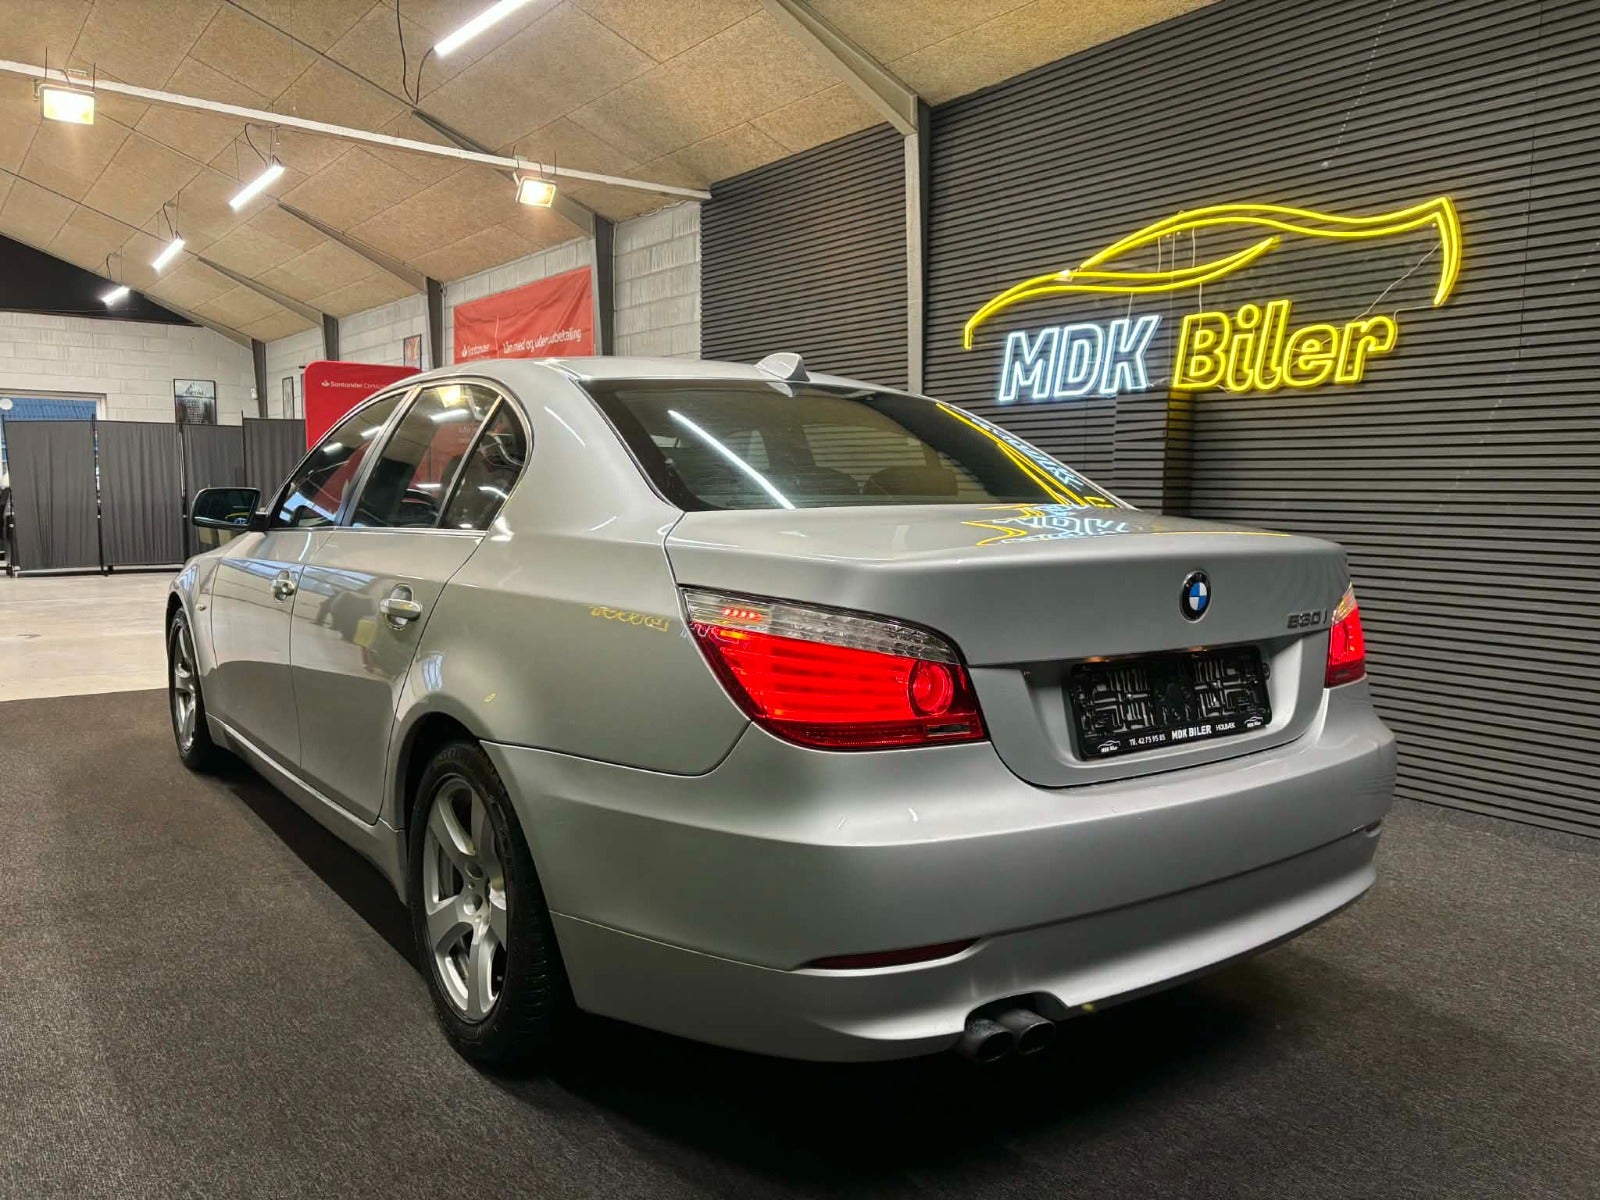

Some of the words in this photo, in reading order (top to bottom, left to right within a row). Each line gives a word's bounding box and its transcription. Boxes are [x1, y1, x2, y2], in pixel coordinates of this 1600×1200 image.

[999, 315, 1162, 401] MDK
[1173, 300, 1398, 392] Biler
[1138, 737, 1145, 745] 42
[1171, 728, 1188, 740] MDK
[1188, 724, 1212, 738] BILER
